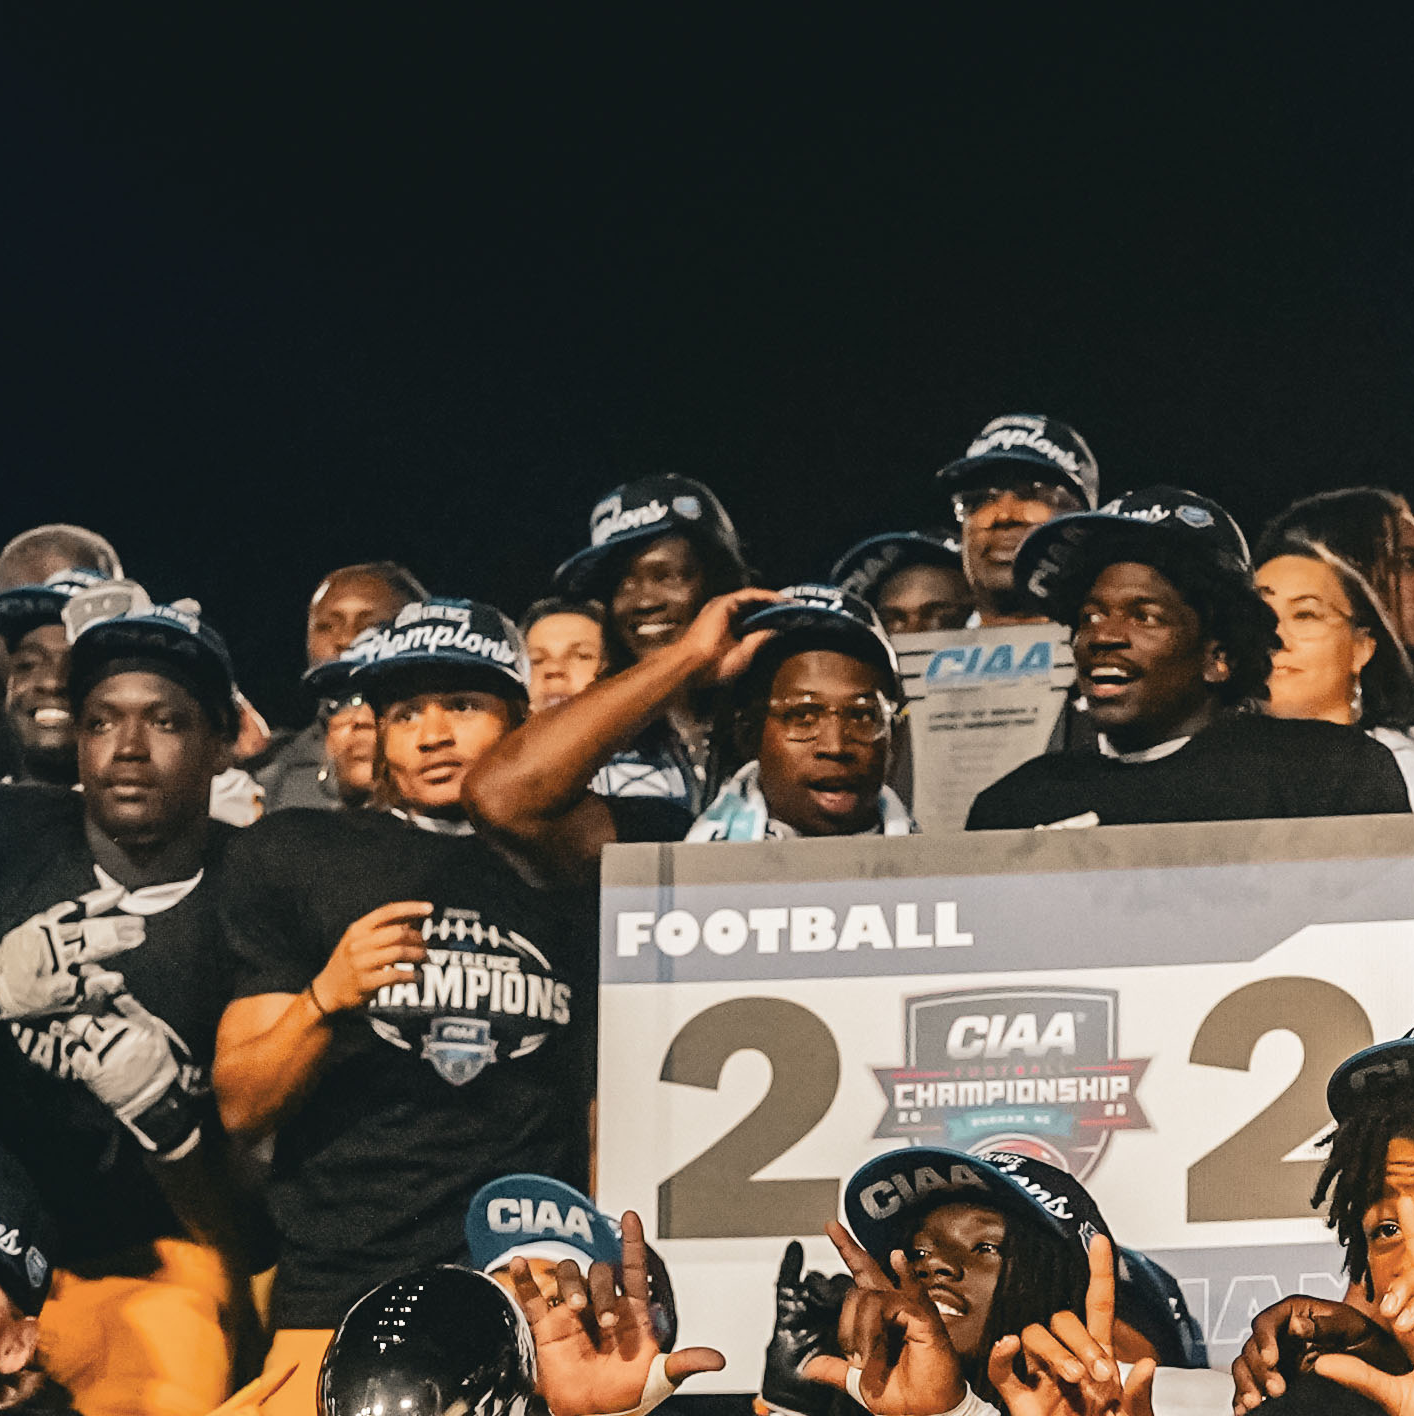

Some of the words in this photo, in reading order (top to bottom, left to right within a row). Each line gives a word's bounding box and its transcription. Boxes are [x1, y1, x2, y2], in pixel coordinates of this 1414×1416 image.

[925, 641, 1054, 688] CIAA
[616, 901, 975, 957] FOOTBALL
[946, 1011, 1077, 1060] CIAA
[893, 1075, 1131, 1109] CHAMPIONSHIP
[858, 1164, 991, 1221] CIAA
[487, 1198, 594, 1244] CIAA
